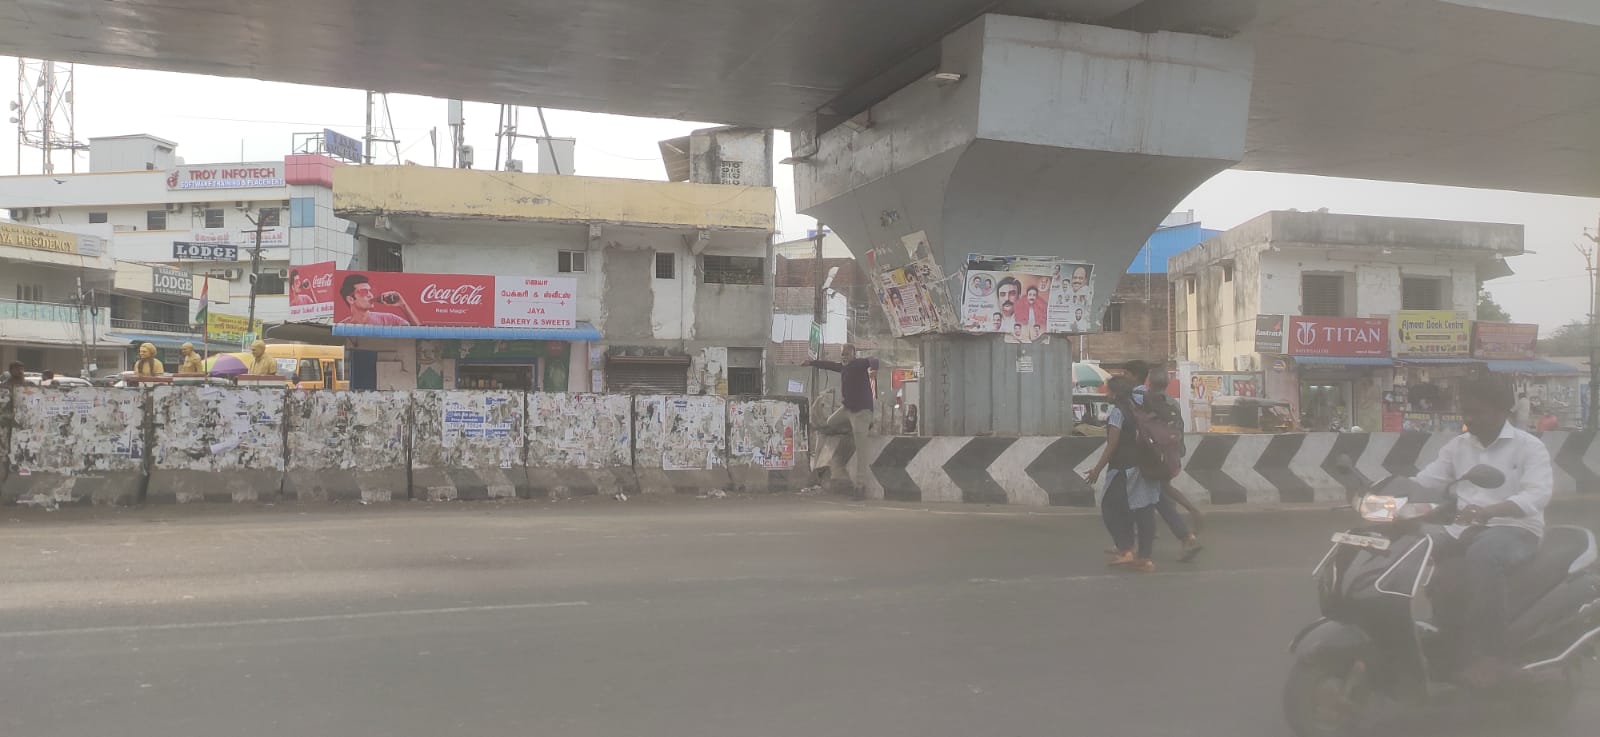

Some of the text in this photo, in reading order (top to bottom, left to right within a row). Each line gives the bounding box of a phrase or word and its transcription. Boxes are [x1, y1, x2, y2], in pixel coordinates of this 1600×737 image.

[189, 168, 276, 180] TROY INFOTECH
[17, 234, 72, 251] RESIDENCY
[176, 245, 236, 258] LODGE
[154, 274, 192, 291] LODGE
[420, 283, 486, 305] Coca-Cola
[501, 317, 531, 325] BAKERY
[1323, 327, 1381, 343] TITAN
